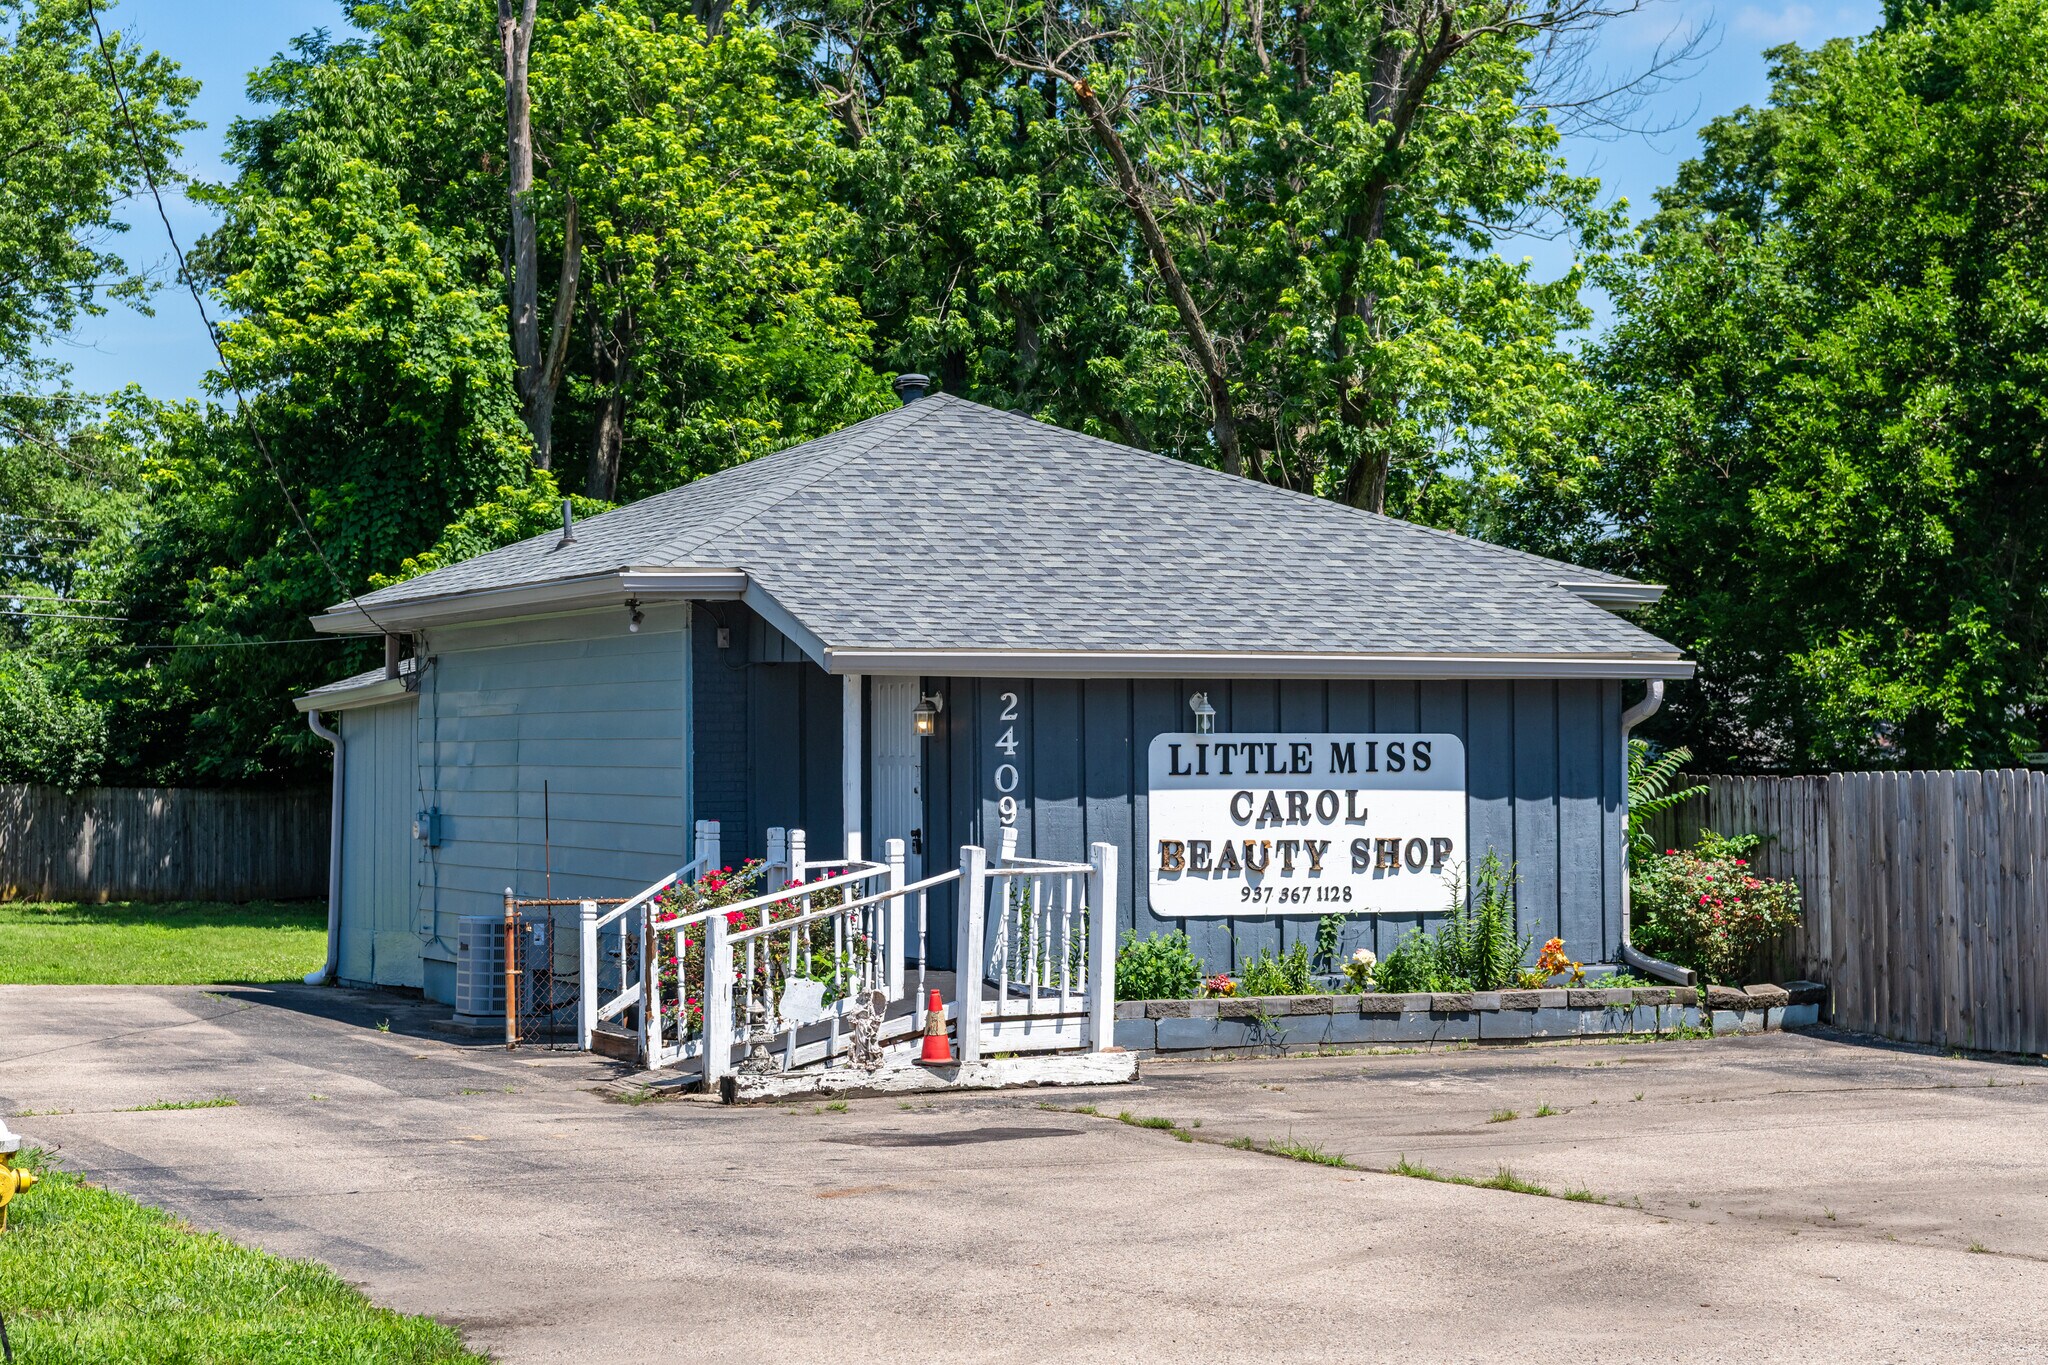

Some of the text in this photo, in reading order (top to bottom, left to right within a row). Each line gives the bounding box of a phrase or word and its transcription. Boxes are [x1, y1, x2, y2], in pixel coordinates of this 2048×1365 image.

[994, 692, 1019, 825] 2409
[1168, 741, 1432, 776] LITTLE MISS
[1230, 789, 1368, 822] CAROL
[1158, 837, 1453, 874] BEAUTY SHOP
[1240, 886, 1352, 904] 937 367 1128
